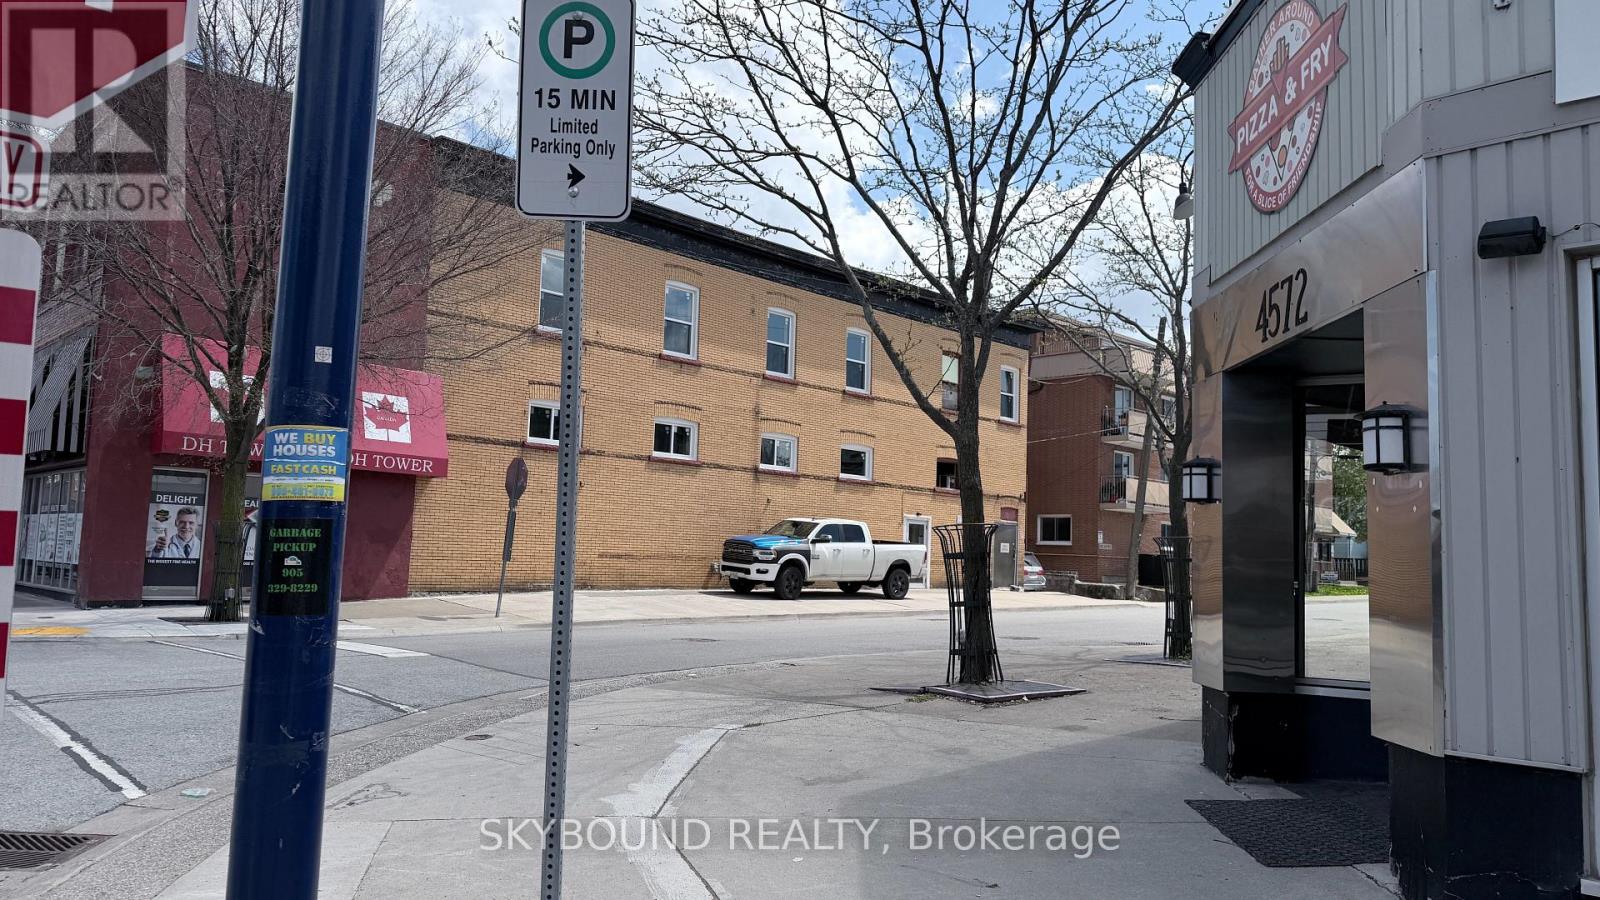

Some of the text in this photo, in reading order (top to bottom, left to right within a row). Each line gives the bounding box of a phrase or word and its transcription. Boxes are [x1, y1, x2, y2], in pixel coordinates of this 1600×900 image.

[1278, 1, 1314, 27] AROUND
[563, 19, 595, 59] P
[534, 88, 616, 110] 15 MIN
[1236, 34, 1332, 153] PIZZA & FRY
[550, 117, 598, 134] Limited
[531, 138, 616, 160] Parking Only
[1245, 102, 1322, 208] FOR A SLICE OF FRIENDSHIP
[1255, 268, 1308, 343] 4572
[182, 436, 213, 453] DH
[274, 432, 336, 445] WE BUY
[273, 444, 336, 457] HOUSES
[271, 464, 337, 475] FAST CASH
[350, 453, 433, 473] H TOWER
[156, 494, 198, 504] DELIGHT
[269, 528, 321, 538] GARBAGE
[272, 542, 317, 551] PICKUP
[282, 568, 304, 577] 905
[267, 583, 318, 593] 329-8229
